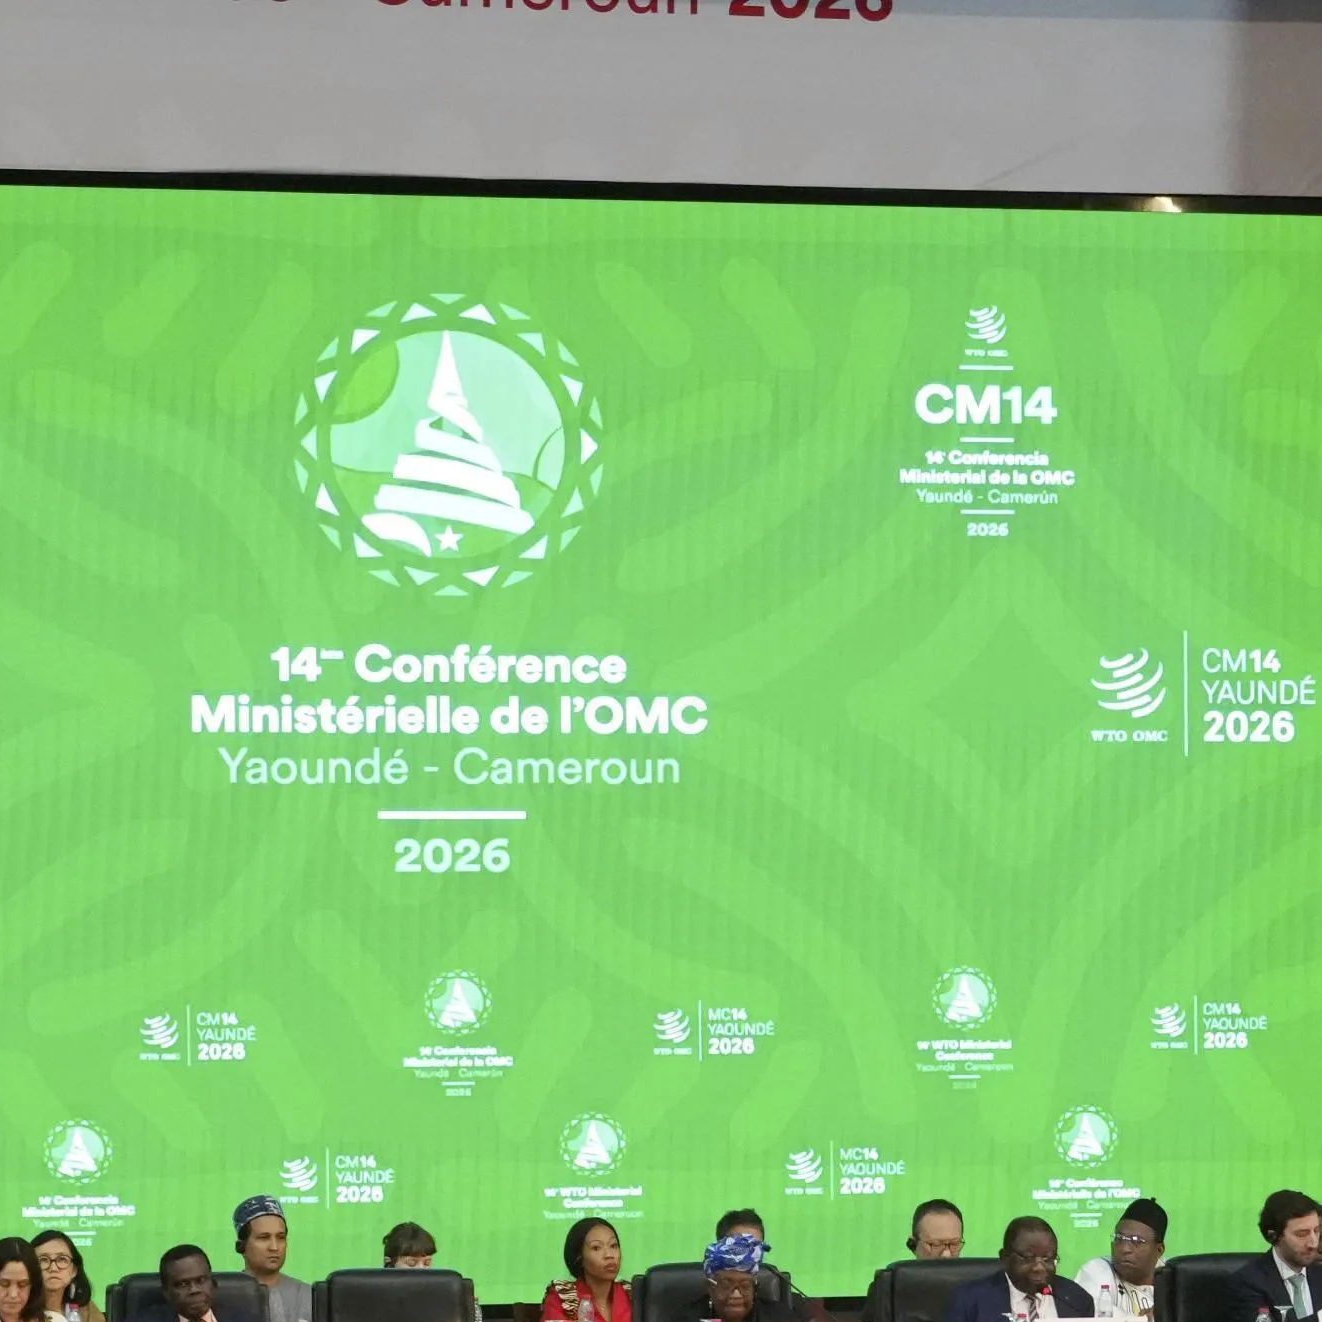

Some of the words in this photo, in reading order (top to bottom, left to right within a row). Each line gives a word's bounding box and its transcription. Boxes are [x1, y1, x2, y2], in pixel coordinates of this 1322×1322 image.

[915, 384, 1057, 424] CM14
[948, 450, 1049, 465] Conferencia
[900, 469, 986, 484] Ministerial
[989, 470, 1010, 484] de
[1013, 470, 1028, 485] la
[1031, 470, 1074, 485] OMC
[917, 489, 973, 503] Yaundé
[988, 489, 1057, 504] Camerún
[967, 523, 1008, 536] 2026
[355, 644, 627, 683] Conférence
[1203, 648, 1281, 673] CM14
[1202, 675, 1316, 705] YAUNDÉ
[192, 694, 479, 734] Ministérielle
[490, 696, 548, 734] de
[1204, 711, 1294, 742] 2026
[1091, 730, 1127, 742] WTO
[1133, 731, 1167, 741] OMC
[219, 747, 408, 784] Yaoundé
[454, 747, 679, 784] Cameroun
[395, 838, 510, 873] 2026
[708, 1008, 747, 1020] MC14
[1204, 1003, 1241, 1015] CM14
[197, 1012, 238, 1025] CM14
[1203, 1014, 1267, 1030] YAOUNDÉ
[197, 1024, 255, 1041] YAUNDÉ
[708, 1018, 774, 1039] YAOUNDÉ
[709, 1037, 754, 1054] 2026
[1204, 1032, 1248, 1048] 2026
[198, 1043, 245, 1060] 2026
[336, 1156, 376, 1168] CM14
[841, 1148, 878, 1160] MC14
[336, 1166, 393, 1184] YAUNDÉ
[840, 1158, 905, 1175] YAOUNDÉ
[337, 1186, 383, 1202] 2026
[840, 1177, 885, 1194] 2026
